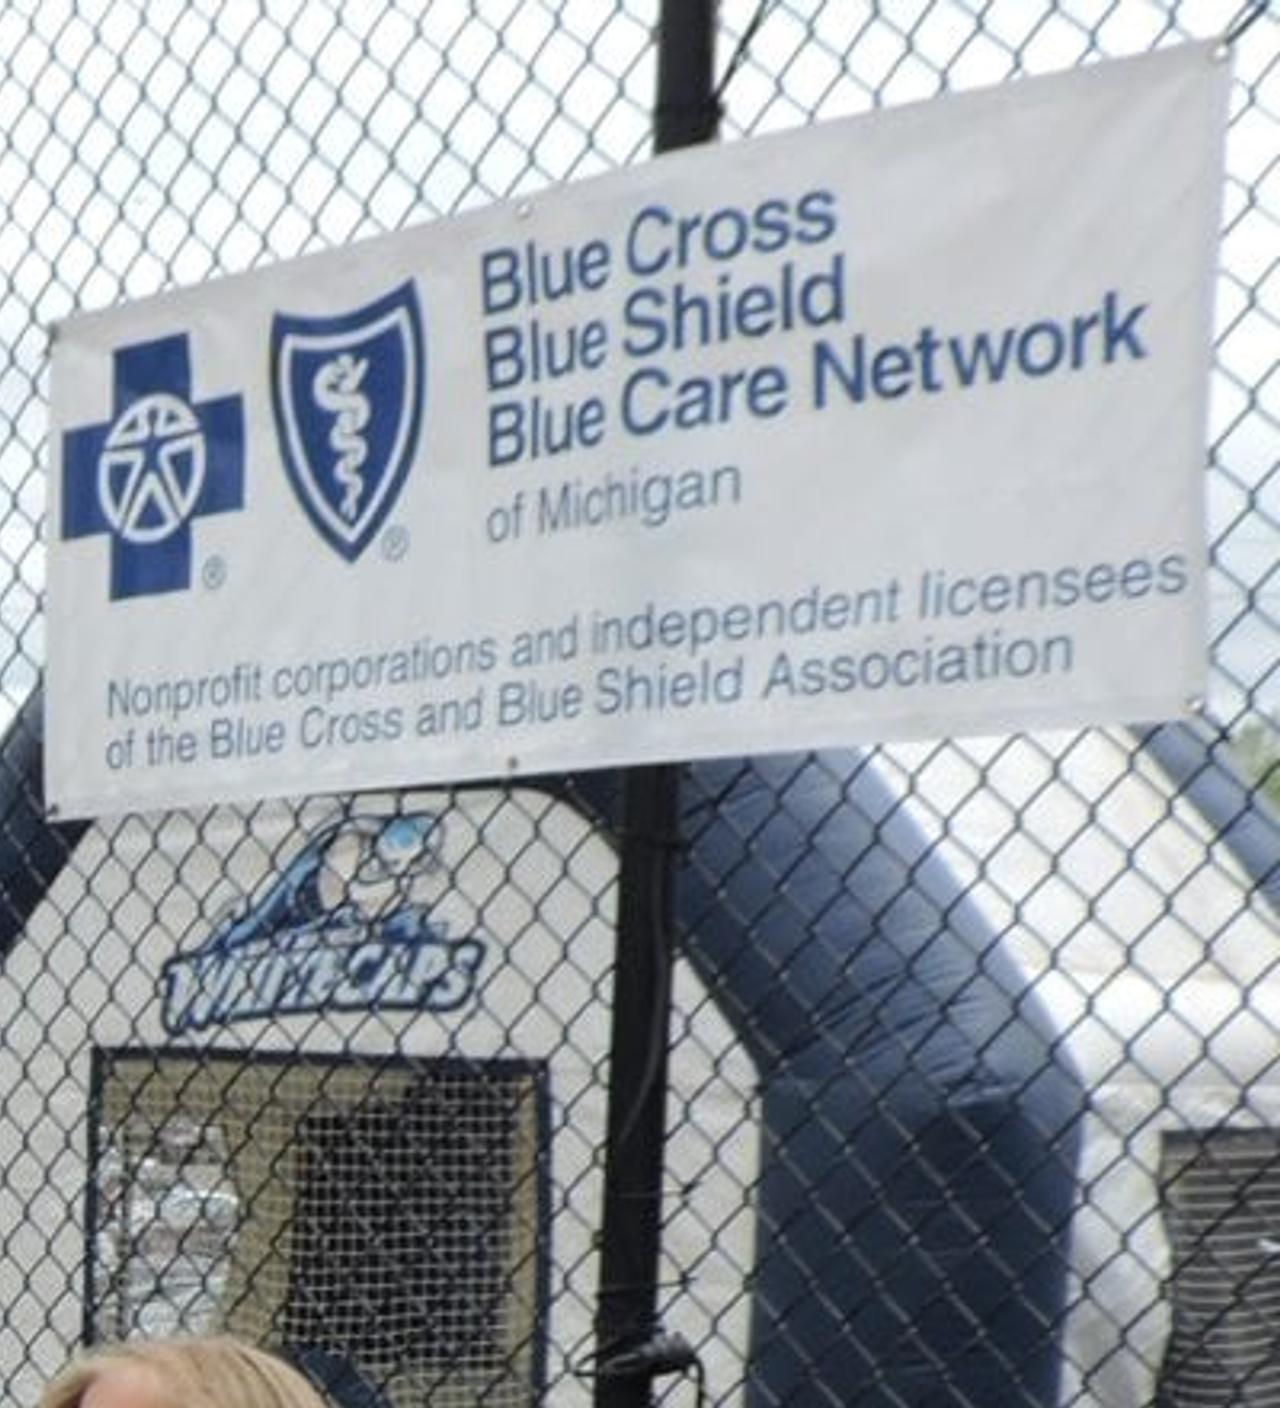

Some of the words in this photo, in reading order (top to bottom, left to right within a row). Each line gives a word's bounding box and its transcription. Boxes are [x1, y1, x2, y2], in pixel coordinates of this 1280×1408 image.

[480, 239, 610, 316] Blue
[626, 191, 836, 279] Cross
[484, 316, 608, 391] Blue
[622, 254, 845, 360] Shield
[487, 396, 606, 468] Blue
[621, 364, 788, 437] Care
[812, 292, 1148, 409] Network
[486, 490, 523, 544] of
[538, 463, 741, 536] Michigan
[106, 724, 137, 770] of
[146, 728, 197, 767] the
[210, 716, 286, 760] Blue
[300, 705, 402, 749] Cross
[417, 689, 483, 736] and
[497, 680, 582, 727] Blue
[596, 656, 744, 716] Shield
[762, 633, 1075, 700] Association
[107, 663, 261, 721] Nonprofit
[272, 634, 497, 700] corporations
[511, 616, 578, 664] and
[592, 579, 901, 656] independent
[919, 553, 1189, 620] licensees
